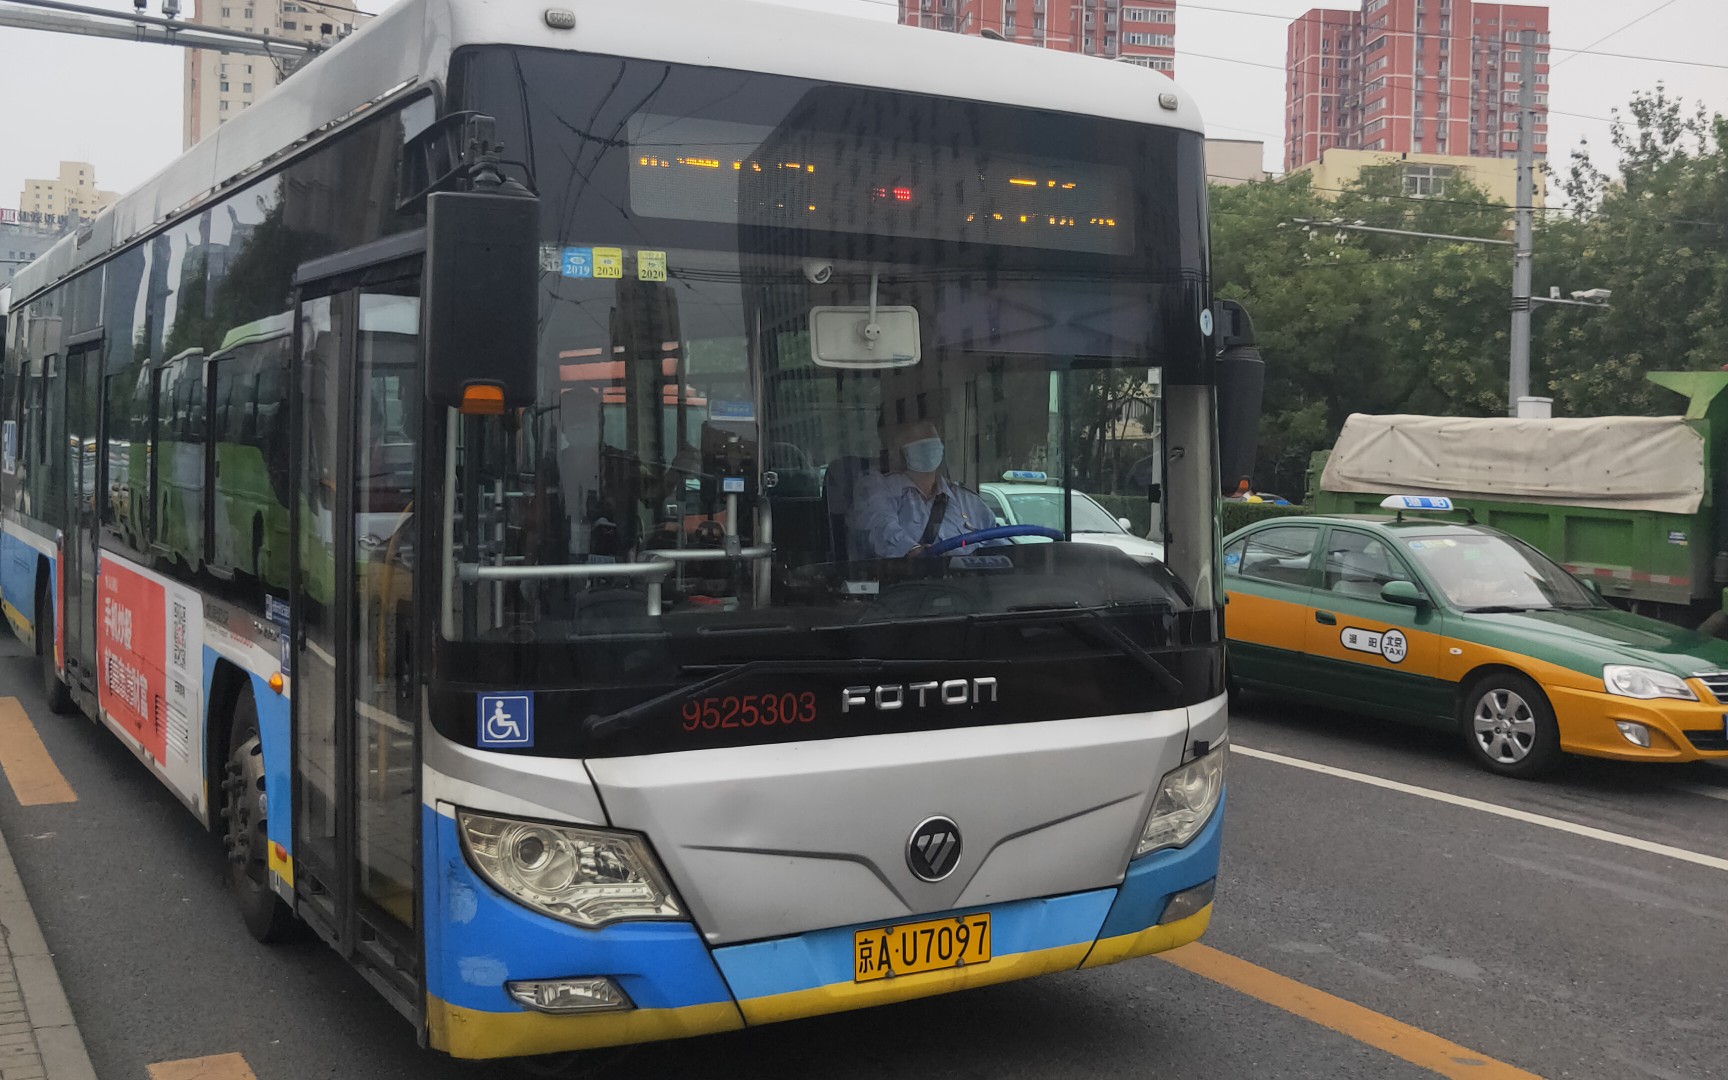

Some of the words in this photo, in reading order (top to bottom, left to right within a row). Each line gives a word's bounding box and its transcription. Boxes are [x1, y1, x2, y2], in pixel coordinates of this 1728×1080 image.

[566, 264, 590, 275] 2019
[597, 266, 620, 276] 2020
[641, 269, 664, 279] 2020
[1386, 636, 1403, 648] 北京
[1384, 646, 1404, 656] TAXI
[841, 676, 998, 713] FOTON
[681, 690, 817, 732] 9525303
